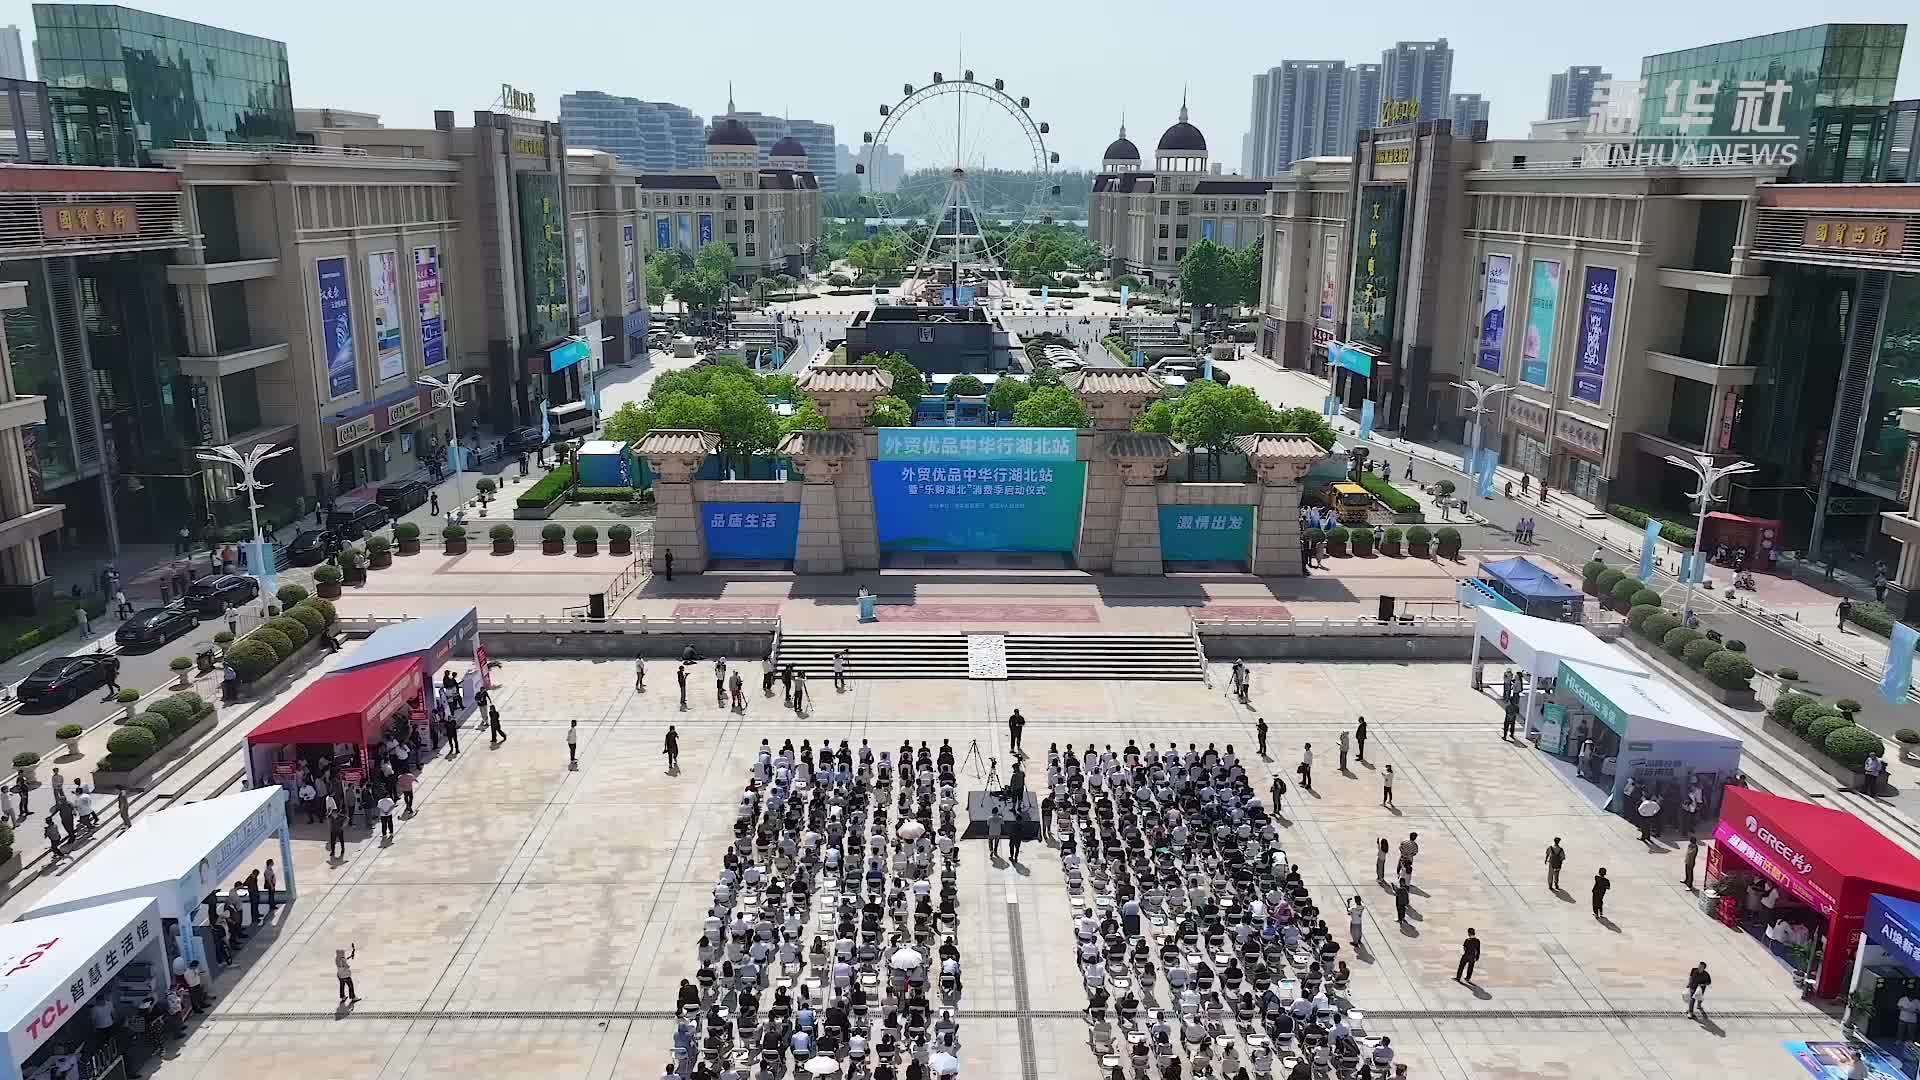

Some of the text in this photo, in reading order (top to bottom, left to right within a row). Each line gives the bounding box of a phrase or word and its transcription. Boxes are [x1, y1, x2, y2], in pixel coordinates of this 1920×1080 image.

[885, 436, 1070, 456] 外贸优品中华行湖北站
[902, 467, 1053, 482] 外贸优品中华行湖北站
[711, 513, 777, 528] 品质生活
[1176, 515, 1243, 530] 激情出发
[1565, 673, 1601, 712] Hisense
[1757, 827, 1793, 861] GREE
[26, 919, 149, 1040] TCL 智慧生活馆
